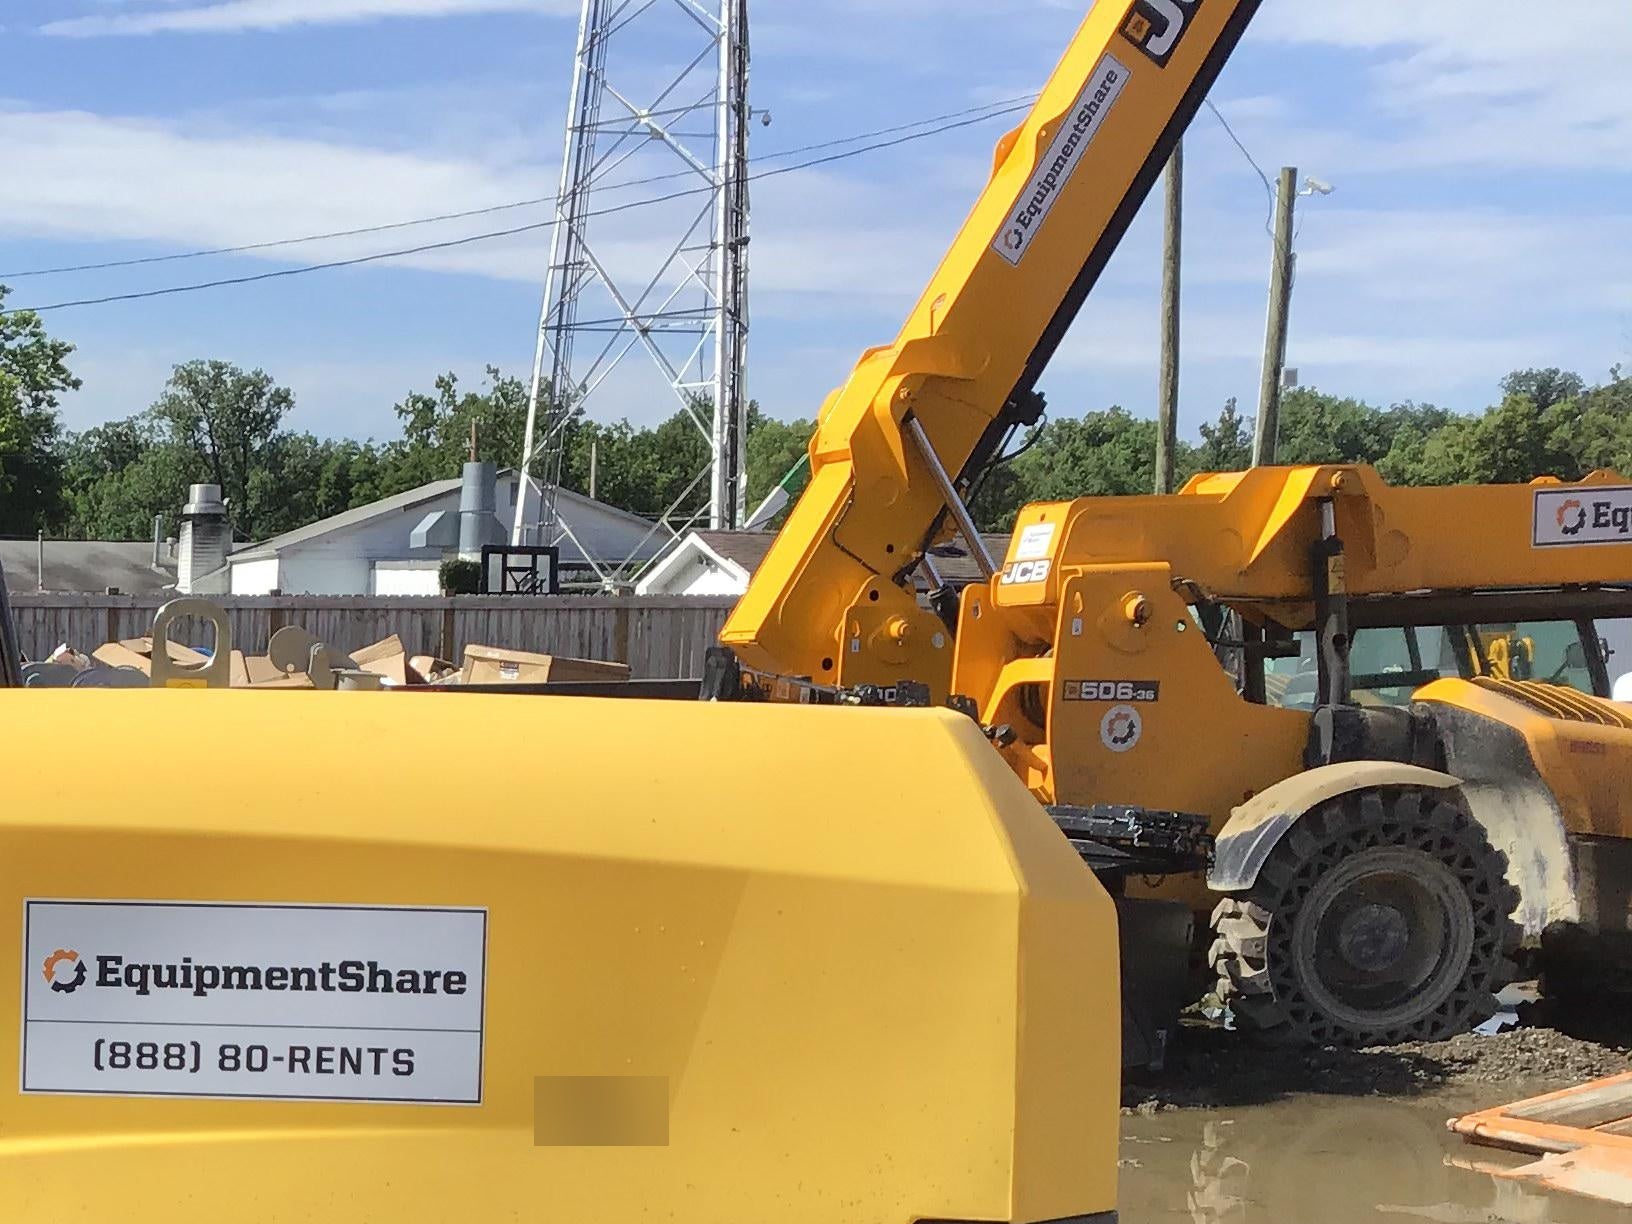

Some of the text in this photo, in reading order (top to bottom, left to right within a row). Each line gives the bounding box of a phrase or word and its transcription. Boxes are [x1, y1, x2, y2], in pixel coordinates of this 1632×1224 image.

[1015, 69, 1118, 229] EquipmentShare
[1592, 501, 1632, 533] Eq
[1001, 559, 1052, 585] JCB
[95, 955, 467, 997] EquipmentShare
[94, 1038, 415, 1076] (888) 80-RENTS
